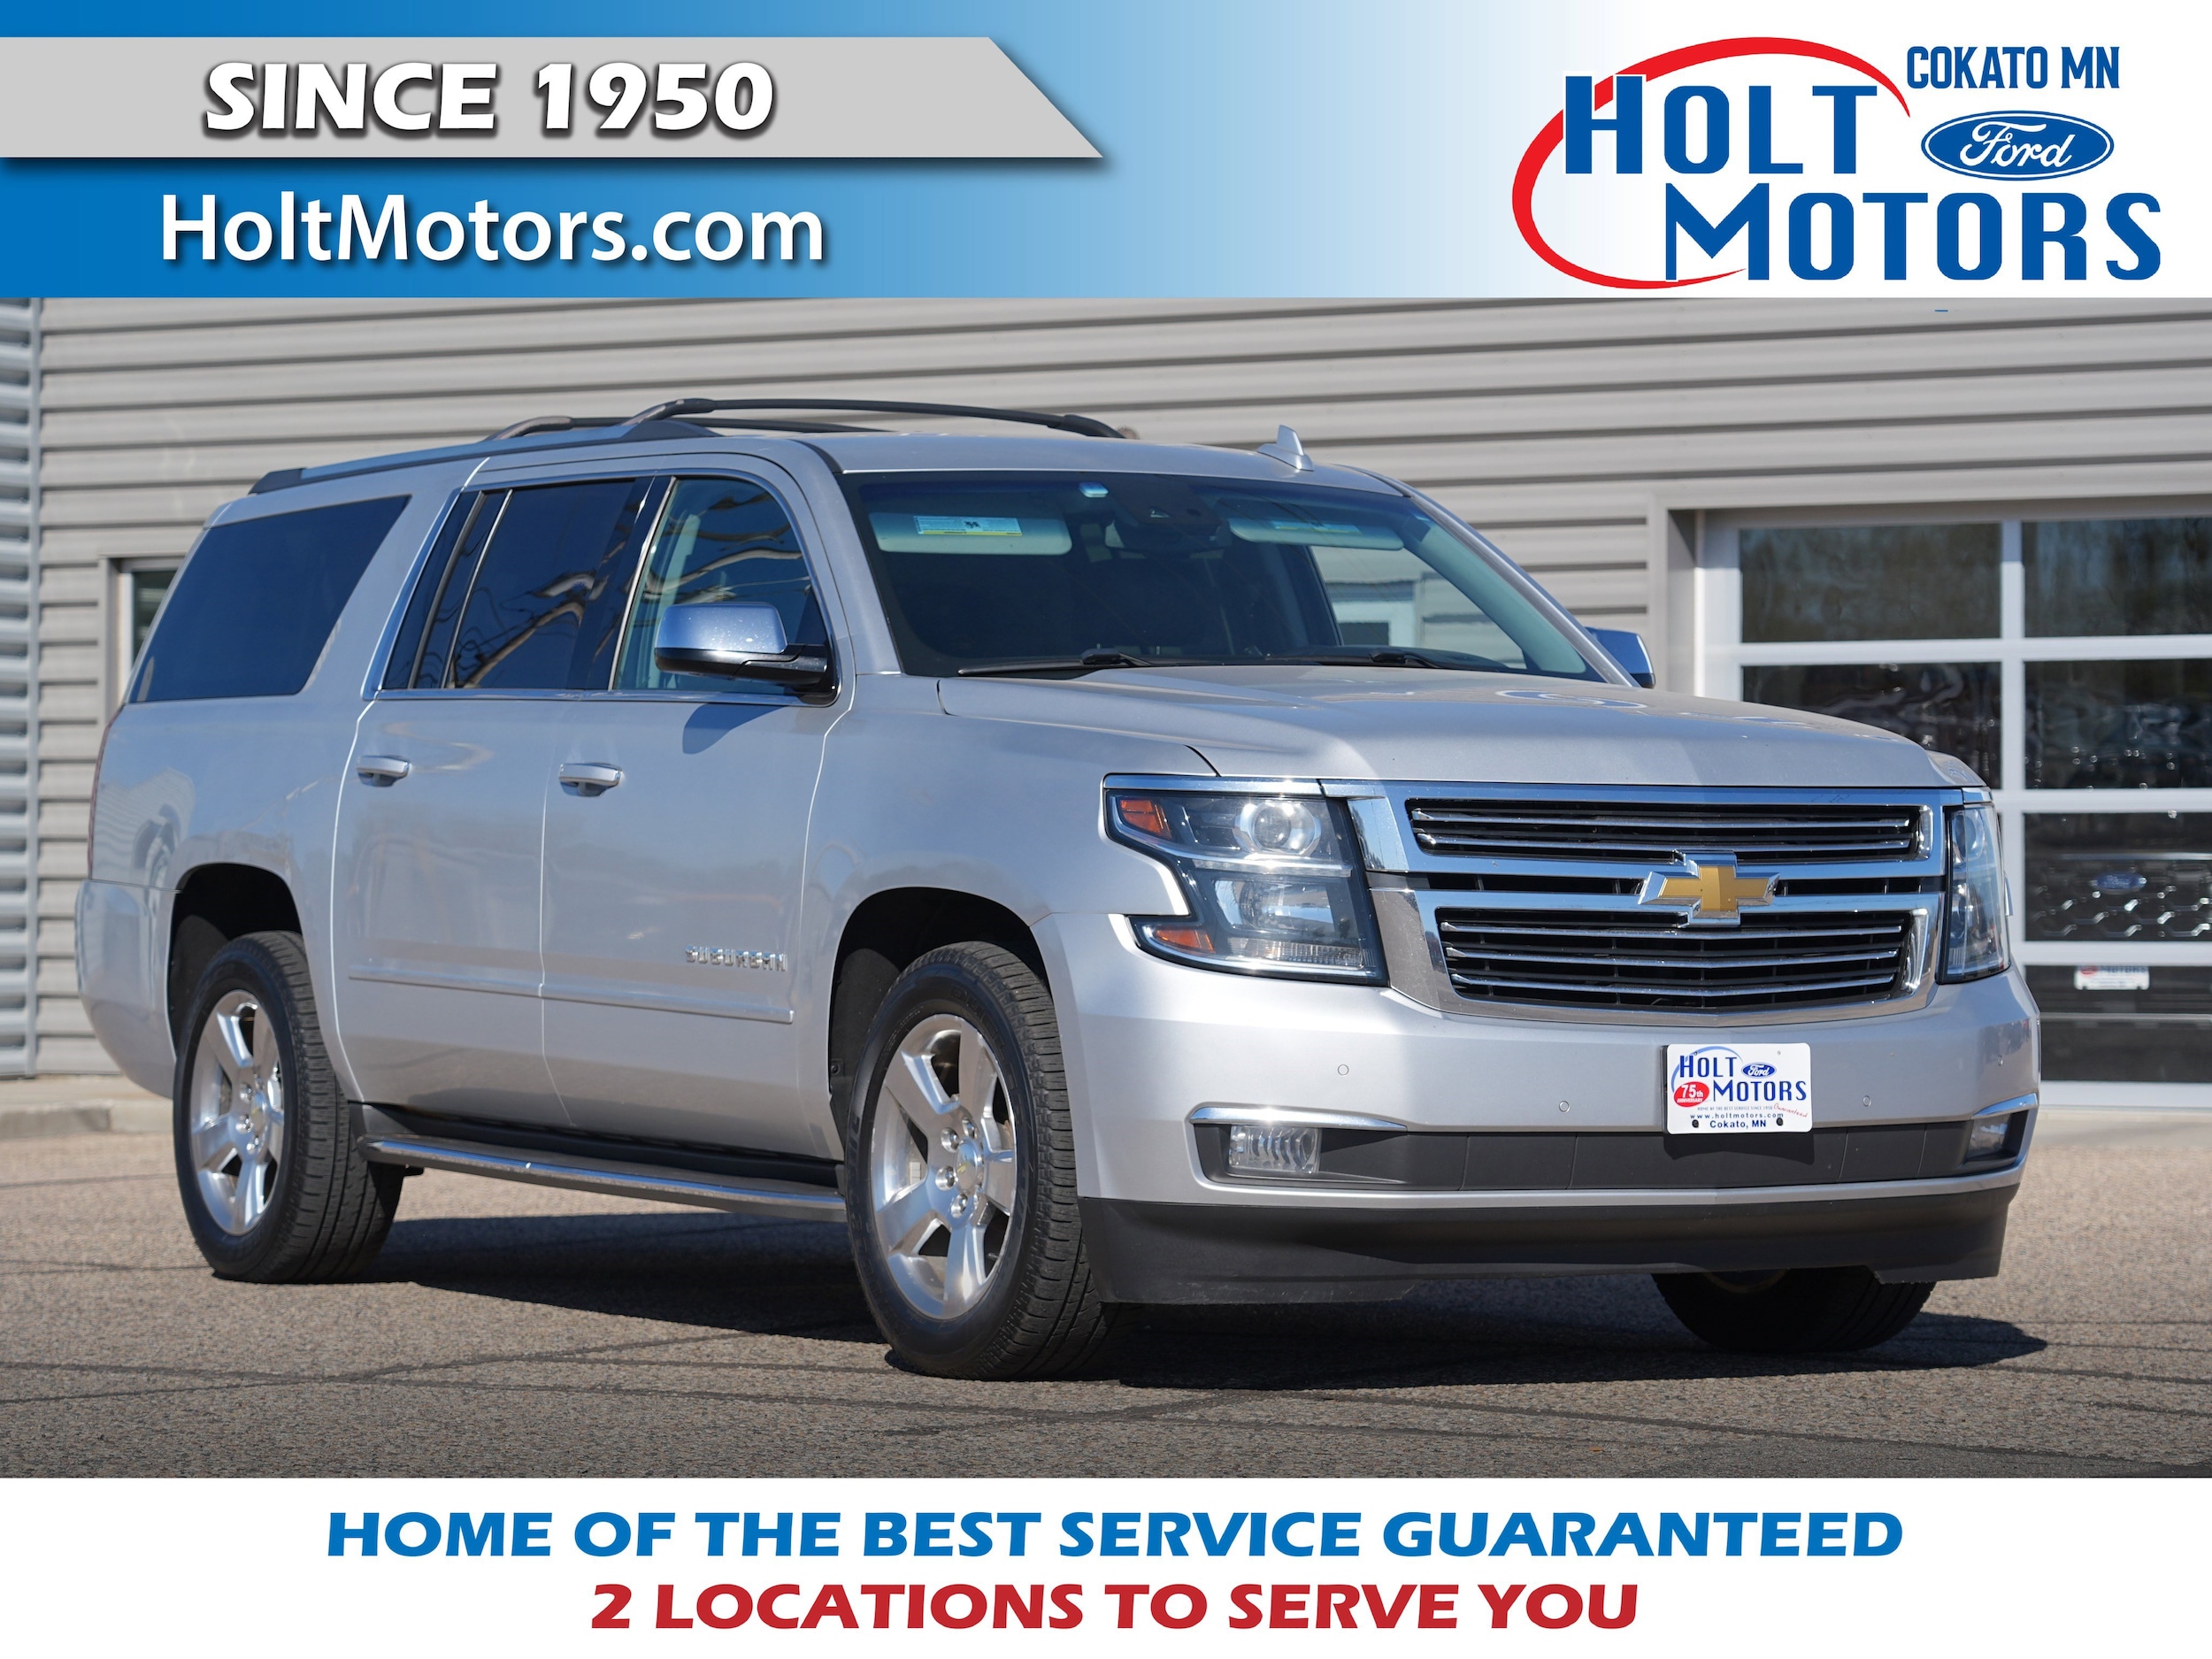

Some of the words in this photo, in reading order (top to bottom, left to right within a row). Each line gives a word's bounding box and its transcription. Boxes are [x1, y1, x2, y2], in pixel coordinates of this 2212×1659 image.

[686, 945, 787, 972] SUBURBAN
[1680, 1055, 1737, 1078] HOLT
[1747, 1064, 1770, 1077] Ford
[1681, 1084, 1703, 1098] 75th
[1713, 1079, 1807, 1102] MOTORS
[1709, 1119, 1748, 1129] Cokato,
[1751, 1119, 1767, 1128] MN
